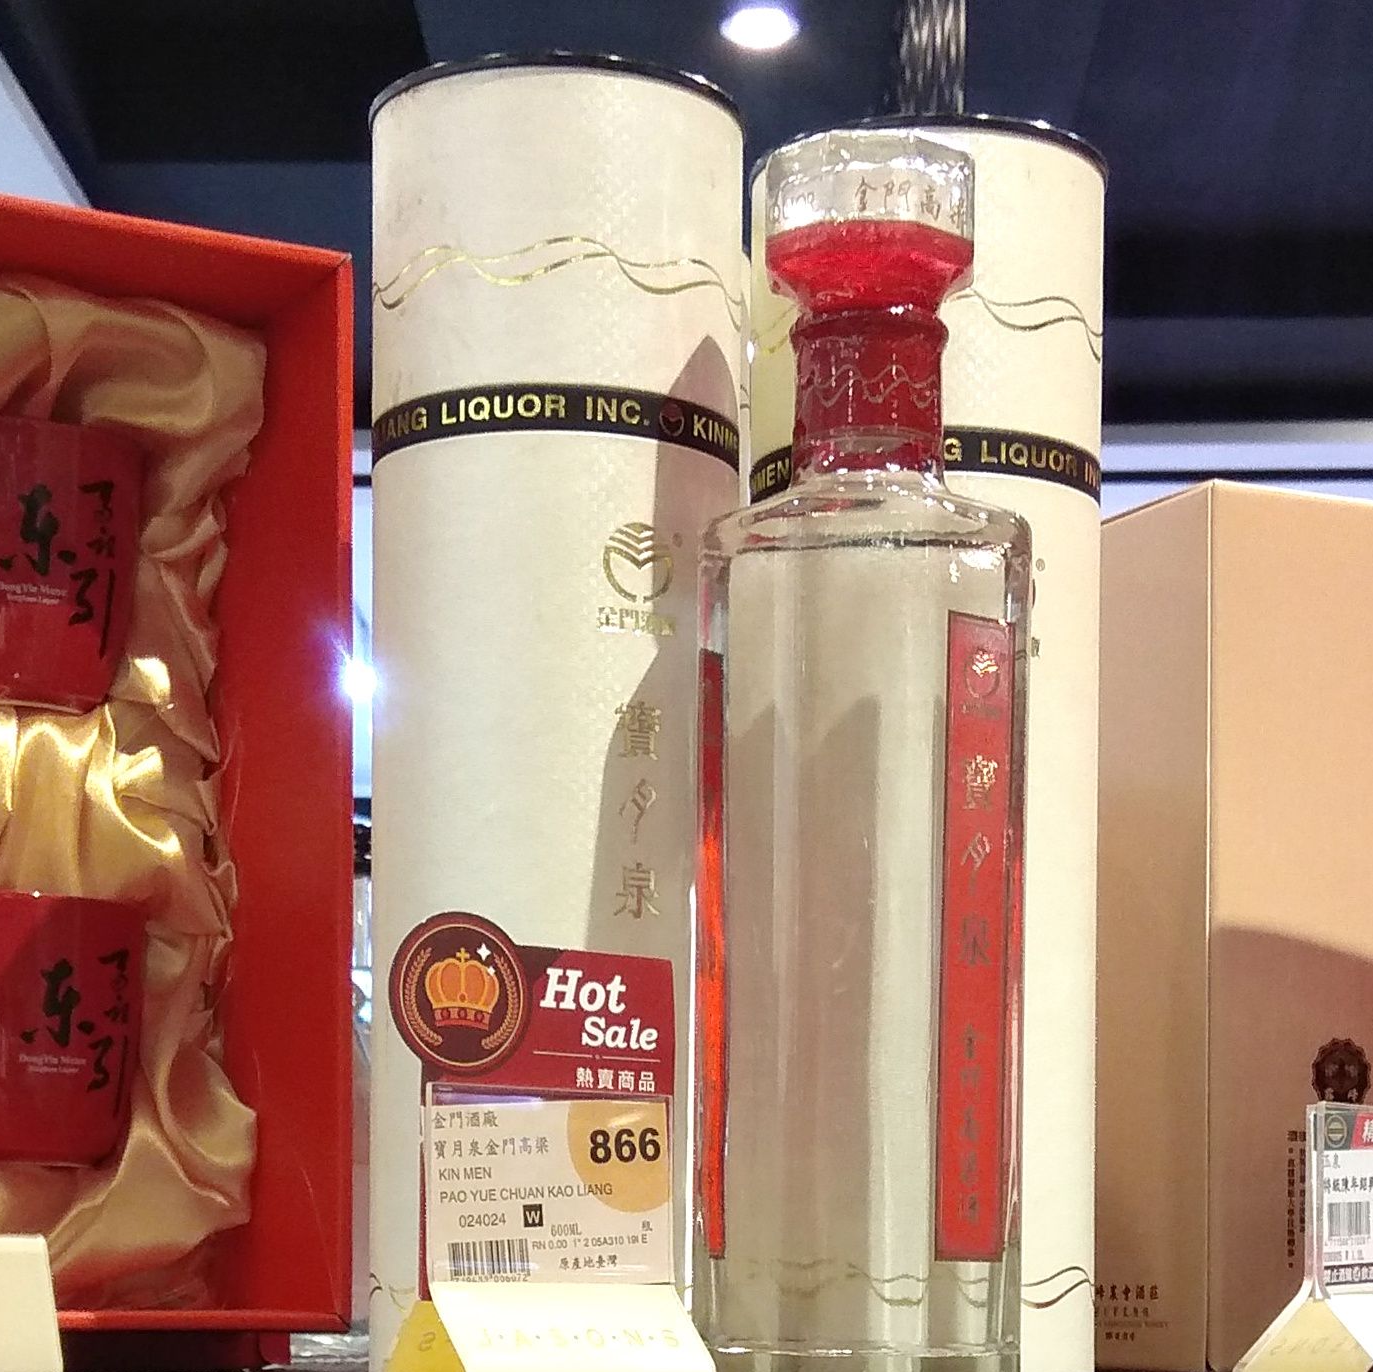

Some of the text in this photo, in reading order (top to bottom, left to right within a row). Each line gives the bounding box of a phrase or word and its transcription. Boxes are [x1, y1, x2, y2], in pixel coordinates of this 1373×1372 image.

[441, 393, 650, 426] LIQUOR INC.
[981, 440, 1078, 475] LIQUOR
[539, 967, 627, 1013] Hot
[581, 1016, 659, 1052] Sale
[575, 1066, 656, 1092] 熱賣商品
[431, 1109, 499, 1130] 金門酒廠
[589, 1127, 662, 1165] 866
[439, 1166, 492, 1181] KIN MEN
[440, 1182, 613, 1204] PAO YUE CHUAN KAO LIANG
[459, 1208, 543, 1229] 024024 W
